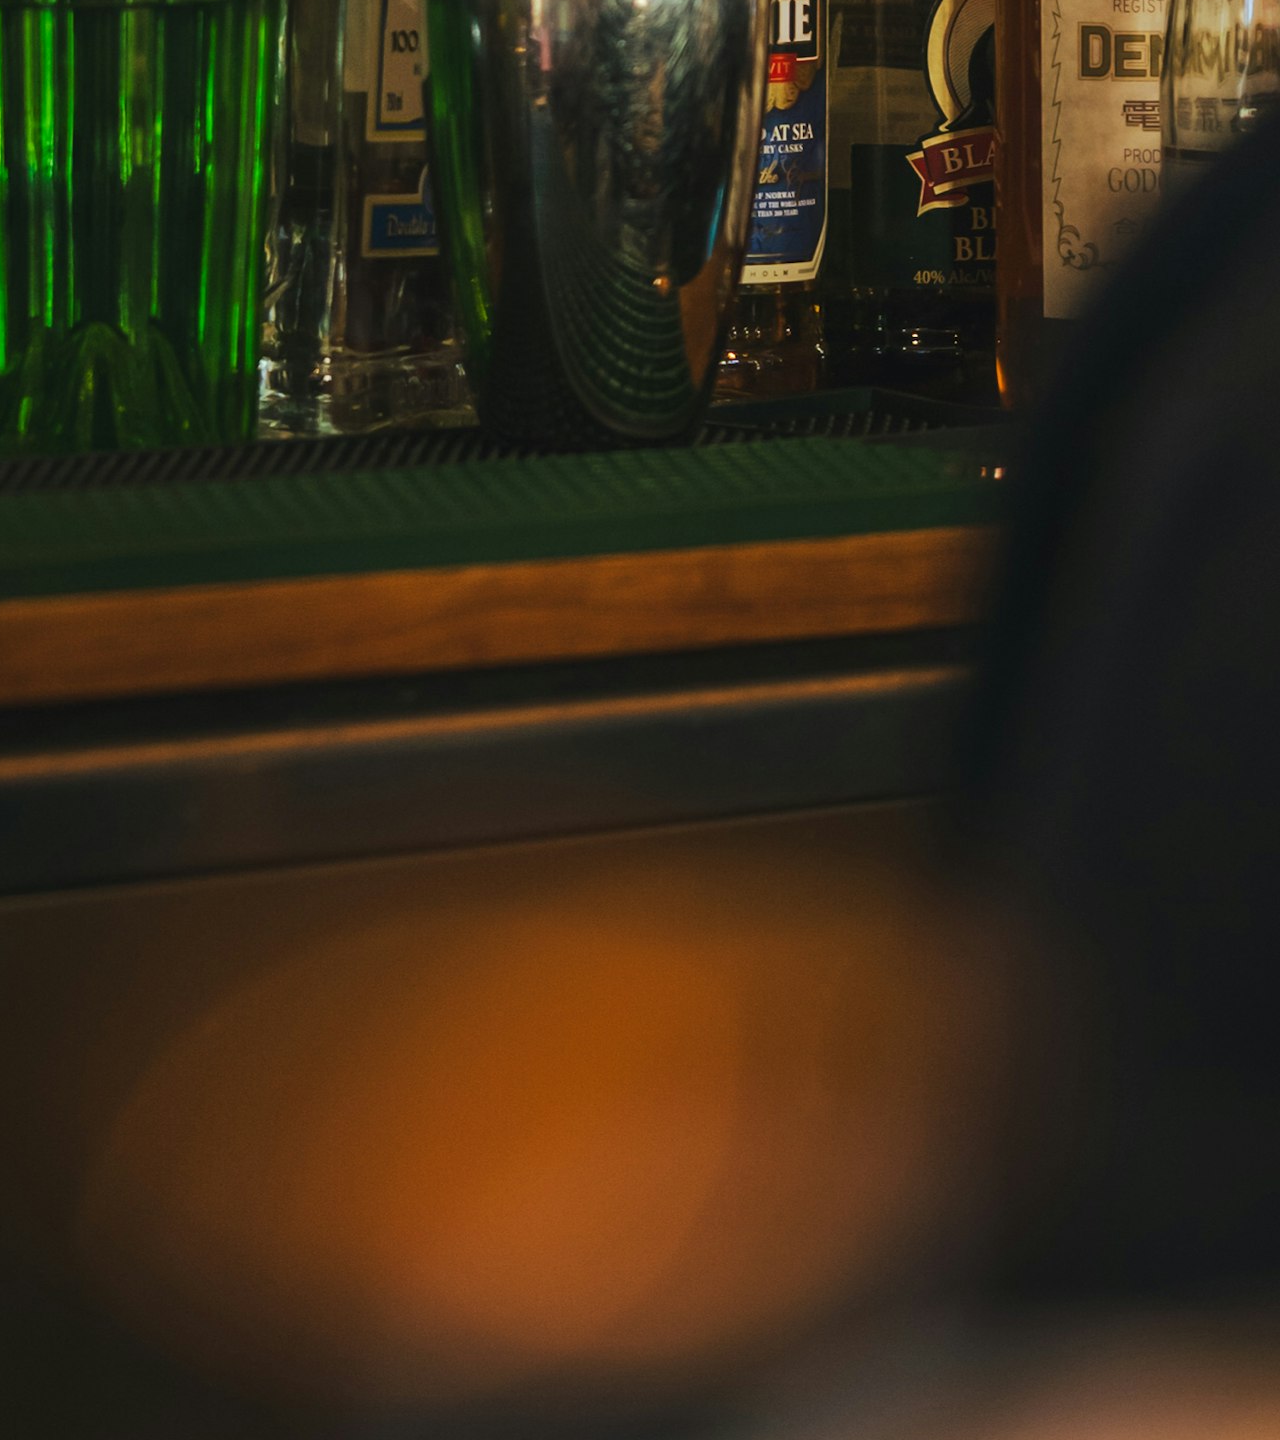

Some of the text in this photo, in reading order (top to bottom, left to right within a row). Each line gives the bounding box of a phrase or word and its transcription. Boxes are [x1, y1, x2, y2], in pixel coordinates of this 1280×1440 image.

[770, 125, 791, 142] AT
[792, 123, 814, 141] SEA
[778, 143, 804, 154] CASKS
[758, 159, 780, 184] the
[1108, 167, 1161, 193] GOD
[765, 191, 796, 200] NORWAY
[749, 269, 789, 277] HOLM
[913, 270, 945, 285] 40%
